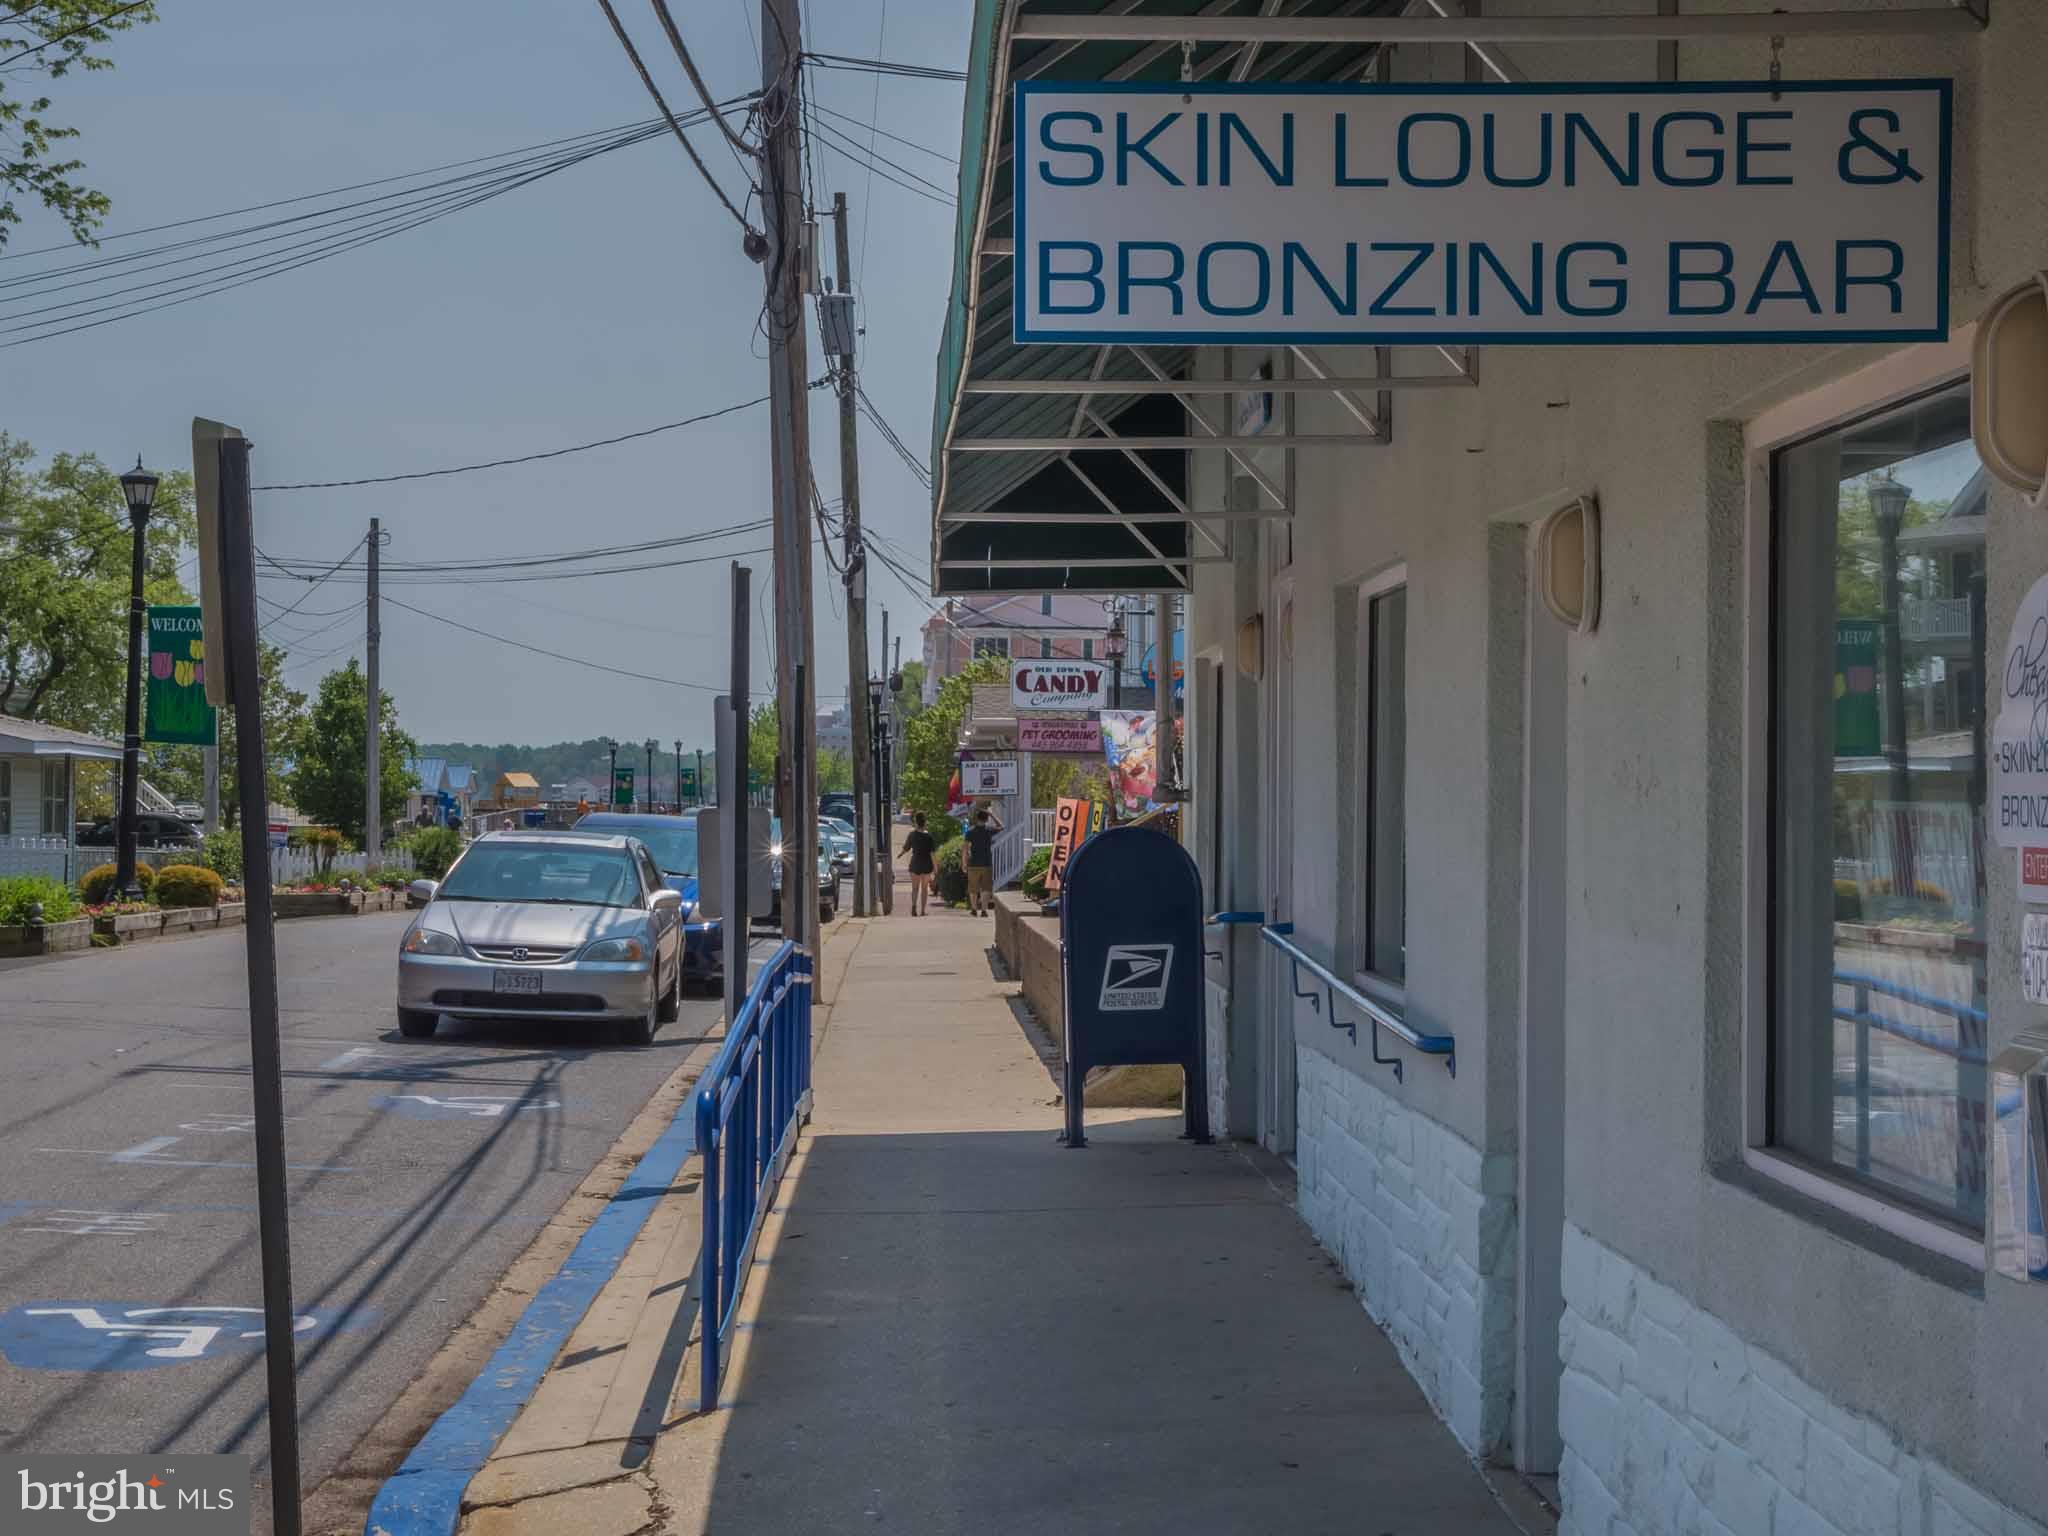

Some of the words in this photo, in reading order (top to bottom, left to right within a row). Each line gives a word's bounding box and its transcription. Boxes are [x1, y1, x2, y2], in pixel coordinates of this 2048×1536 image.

[1039, 111, 1294, 187] SKIN
[1335, 111, 1794, 187] LOUNGE
[1837, 108, 1924, 185] &
[1039, 241, 1628, 317] BRONZING
[1668, 239, 1904, 316] BAR
[1015, 668, 1103, 693] CANDY
[1030, 689, 1094, 706] Company
[1022, 729, 1040, 740] PET
[1041, 729, 1097, 741] GROOMING
[1050, 805, 1073, 881] OPEN
